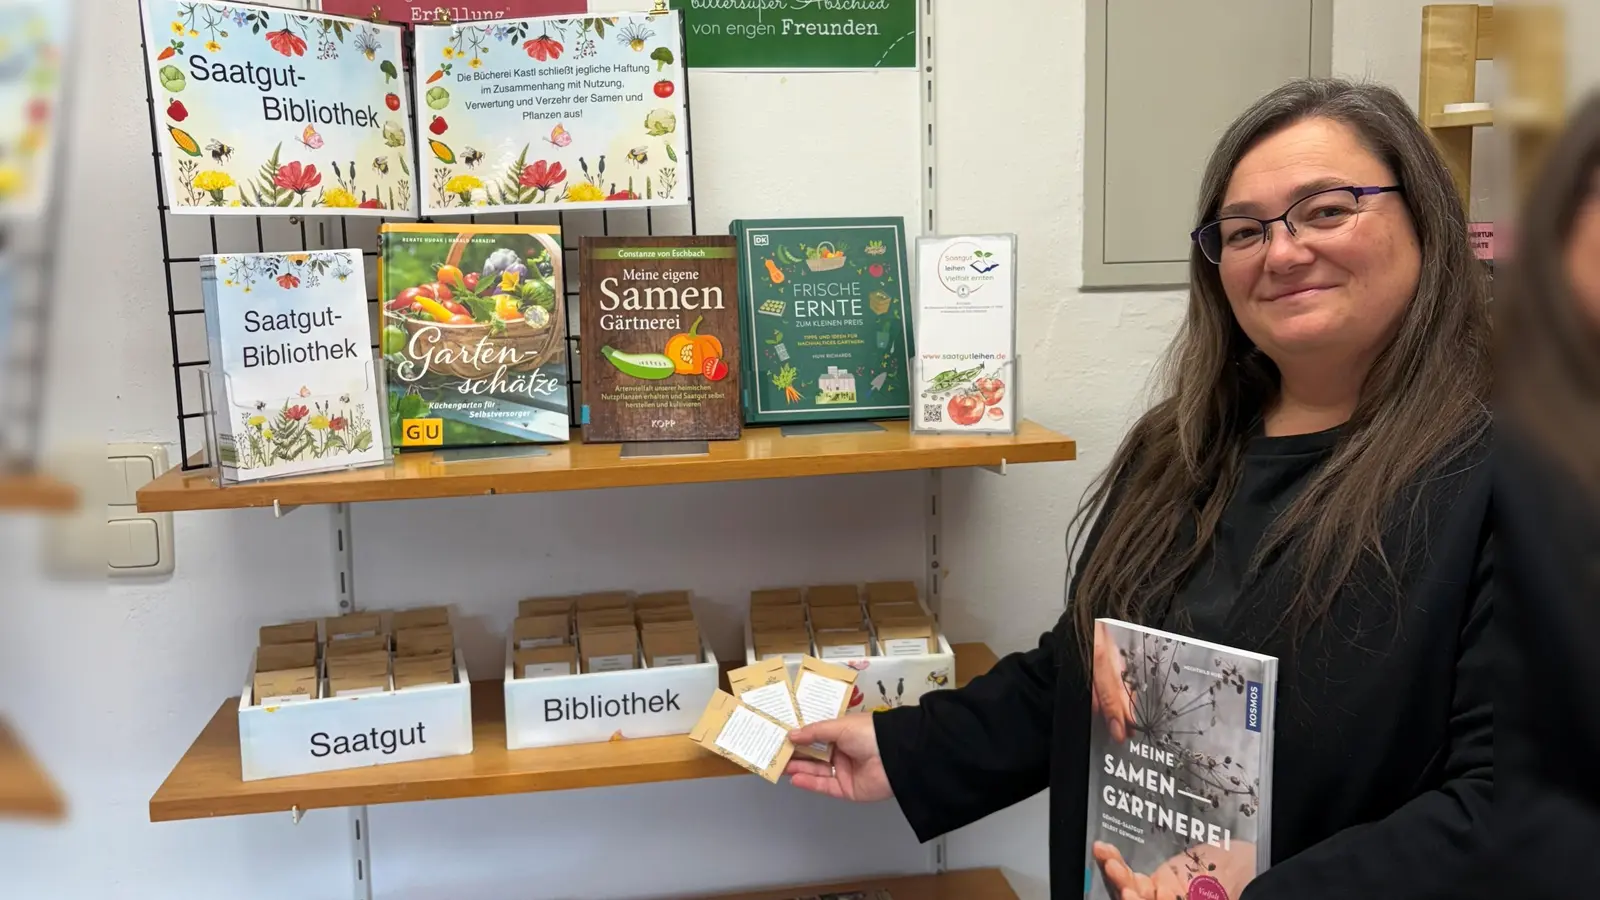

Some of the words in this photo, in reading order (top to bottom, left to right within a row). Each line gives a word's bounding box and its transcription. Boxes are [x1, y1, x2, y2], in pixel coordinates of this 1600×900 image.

[692, 24, 720, 35] von
[726, 24, 775, 39] engen
[781, 19, 879, 35] Freunden
[189, 54, 306, 89] Saatgut-
[457, 73, 472, 82] Die
[474, 70, 512, 81] Bücherei
[514, 68, 536, 78] Kastl
[538, 66, 573, 76] schließt
[575, 65, 611, 76] jegliche
[613, 64, 650, 75] Haftung
[481, 86, 491, 94] im
[493, 82, 565, 94] Zusammenhang
[567, 81, 581, 90] mit
[583, 79, 625, 90] Nutzung,
[465, 100, 514, 110] Verwertung
[516, 97, 533, 106] und
[535, 96, 571, 105] Verzehr
[573, 95, 588, 103] der
[590, 94, 624, 103] Samen
[626, 93, 643, 102] und
[263, 97, 380, 129] Bibliothek
[522, 111, 562, 120] Pflanzen
[564, 109, 583, 118] aus!
[618, 250, 656, 258] Constanze
[672, 249, 705, 258] Eschbach
[945, 255, 972, 263] Saatgut
[623, 269, 659, 281] Meine
[662, 269, 699, 283] eigene
[600, 277, 725, 311] Samen
[793, 282, 861, 297] FRISCHE
[794, 299, 863, 317] ERNTE
[244, 306, 342, 334] Saatgut-
[600, 314, 681, 331] Gärtnerei
[243, 338, 358, 368] Bibliothek
[397, 326, 537, 381] Garten-
[922, 353, 1006, 361] www.saatgutleihen.de
[458, 364, 558, 397] schätze
[429, 401, 482, 410] Küchengarten
[484, 400, 496, 409] für
[601, 393, 642, 401] Nutzpflanzen
[469, 410, 530, 419] Selbstversorger
[651, 420, 676, 428] KOPP
[544, 688, 681, 723] Bibliothek
[1248, 685, 1259, 728] KOSMOS
[310, 722, 427, 757] Saatgut
[1129, 741, 1174, 767] MEINE
[1103, 785, 1230, 850] GÄRTNEREI
[1198, 887, 1220, 900] Vielfalt
